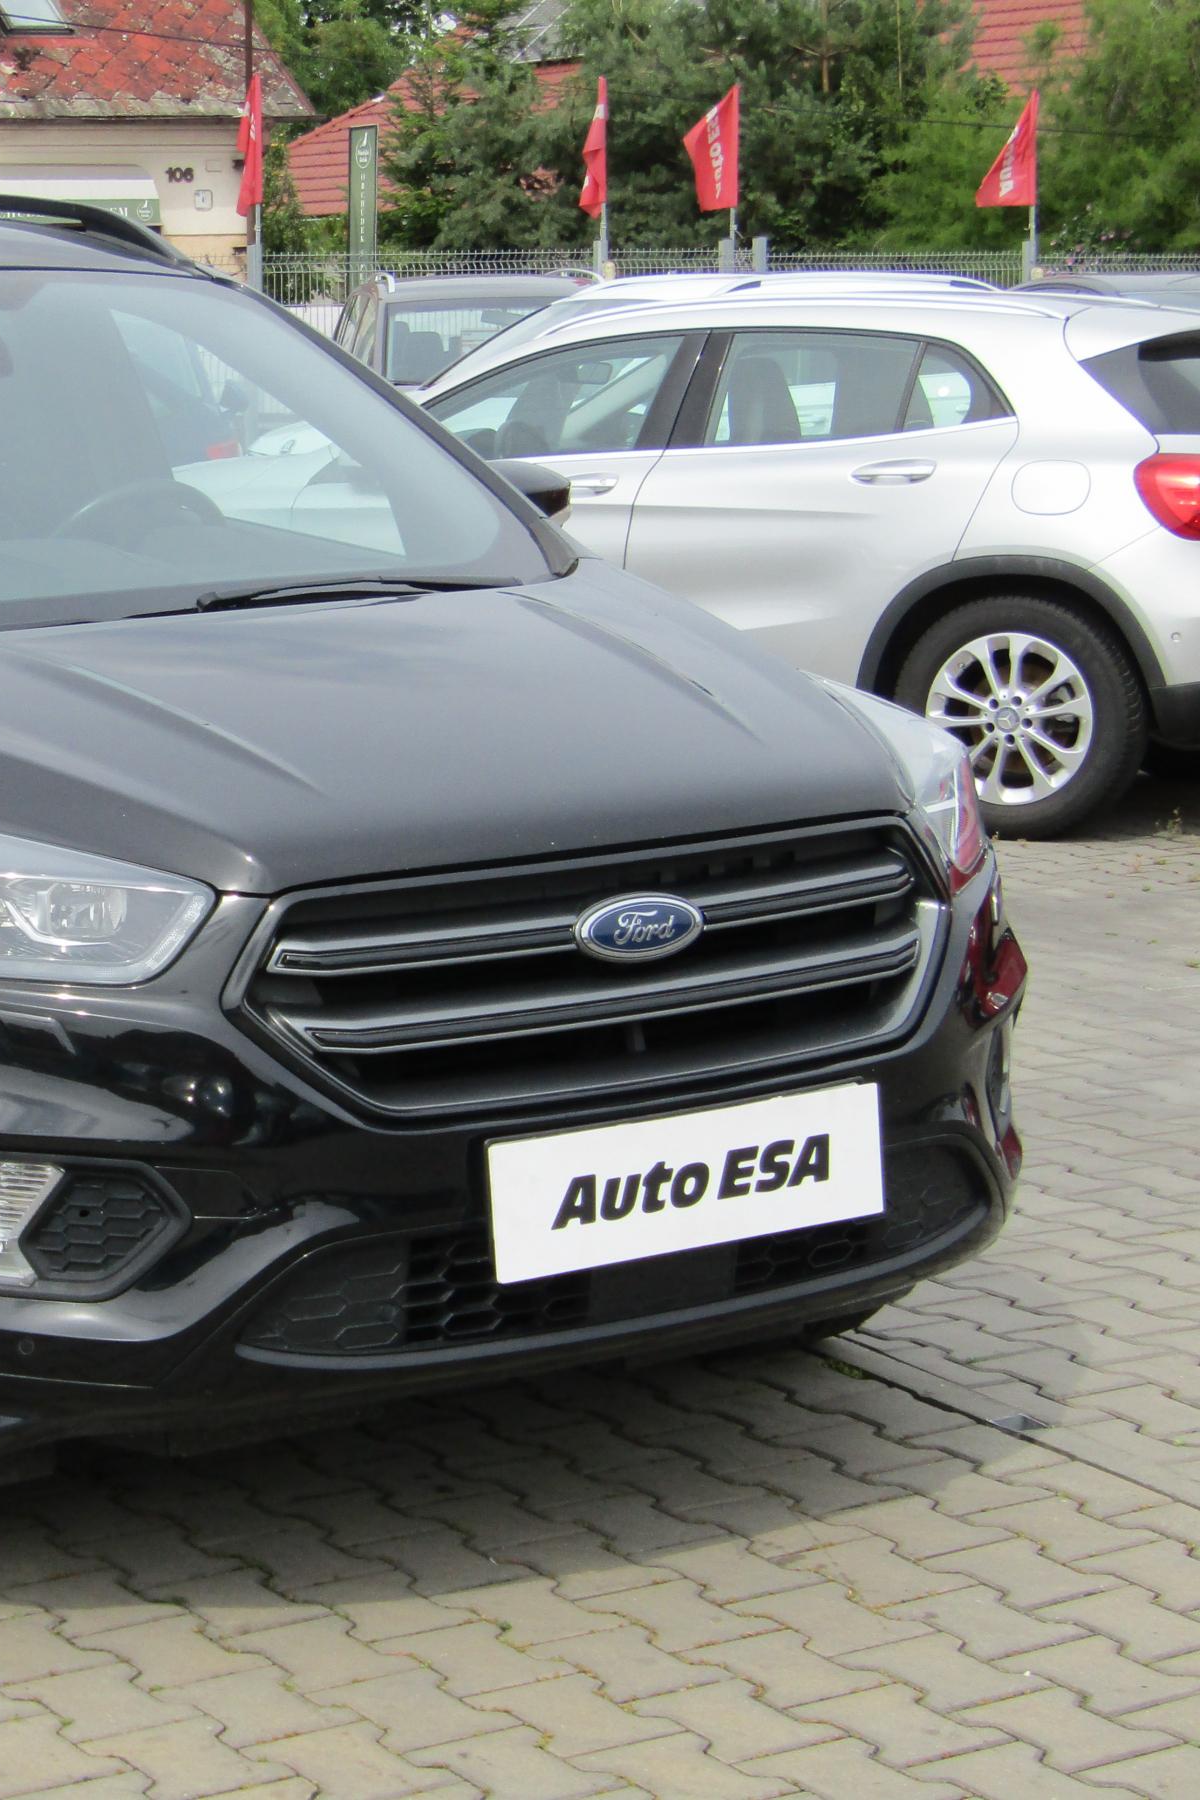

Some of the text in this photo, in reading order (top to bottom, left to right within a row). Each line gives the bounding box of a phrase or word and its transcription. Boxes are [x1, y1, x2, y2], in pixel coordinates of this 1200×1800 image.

[165, 167, 194, 184] 106
[614, 910, 675, 945] Ford
[551, 1133, 830, 1231] Auto ESA
